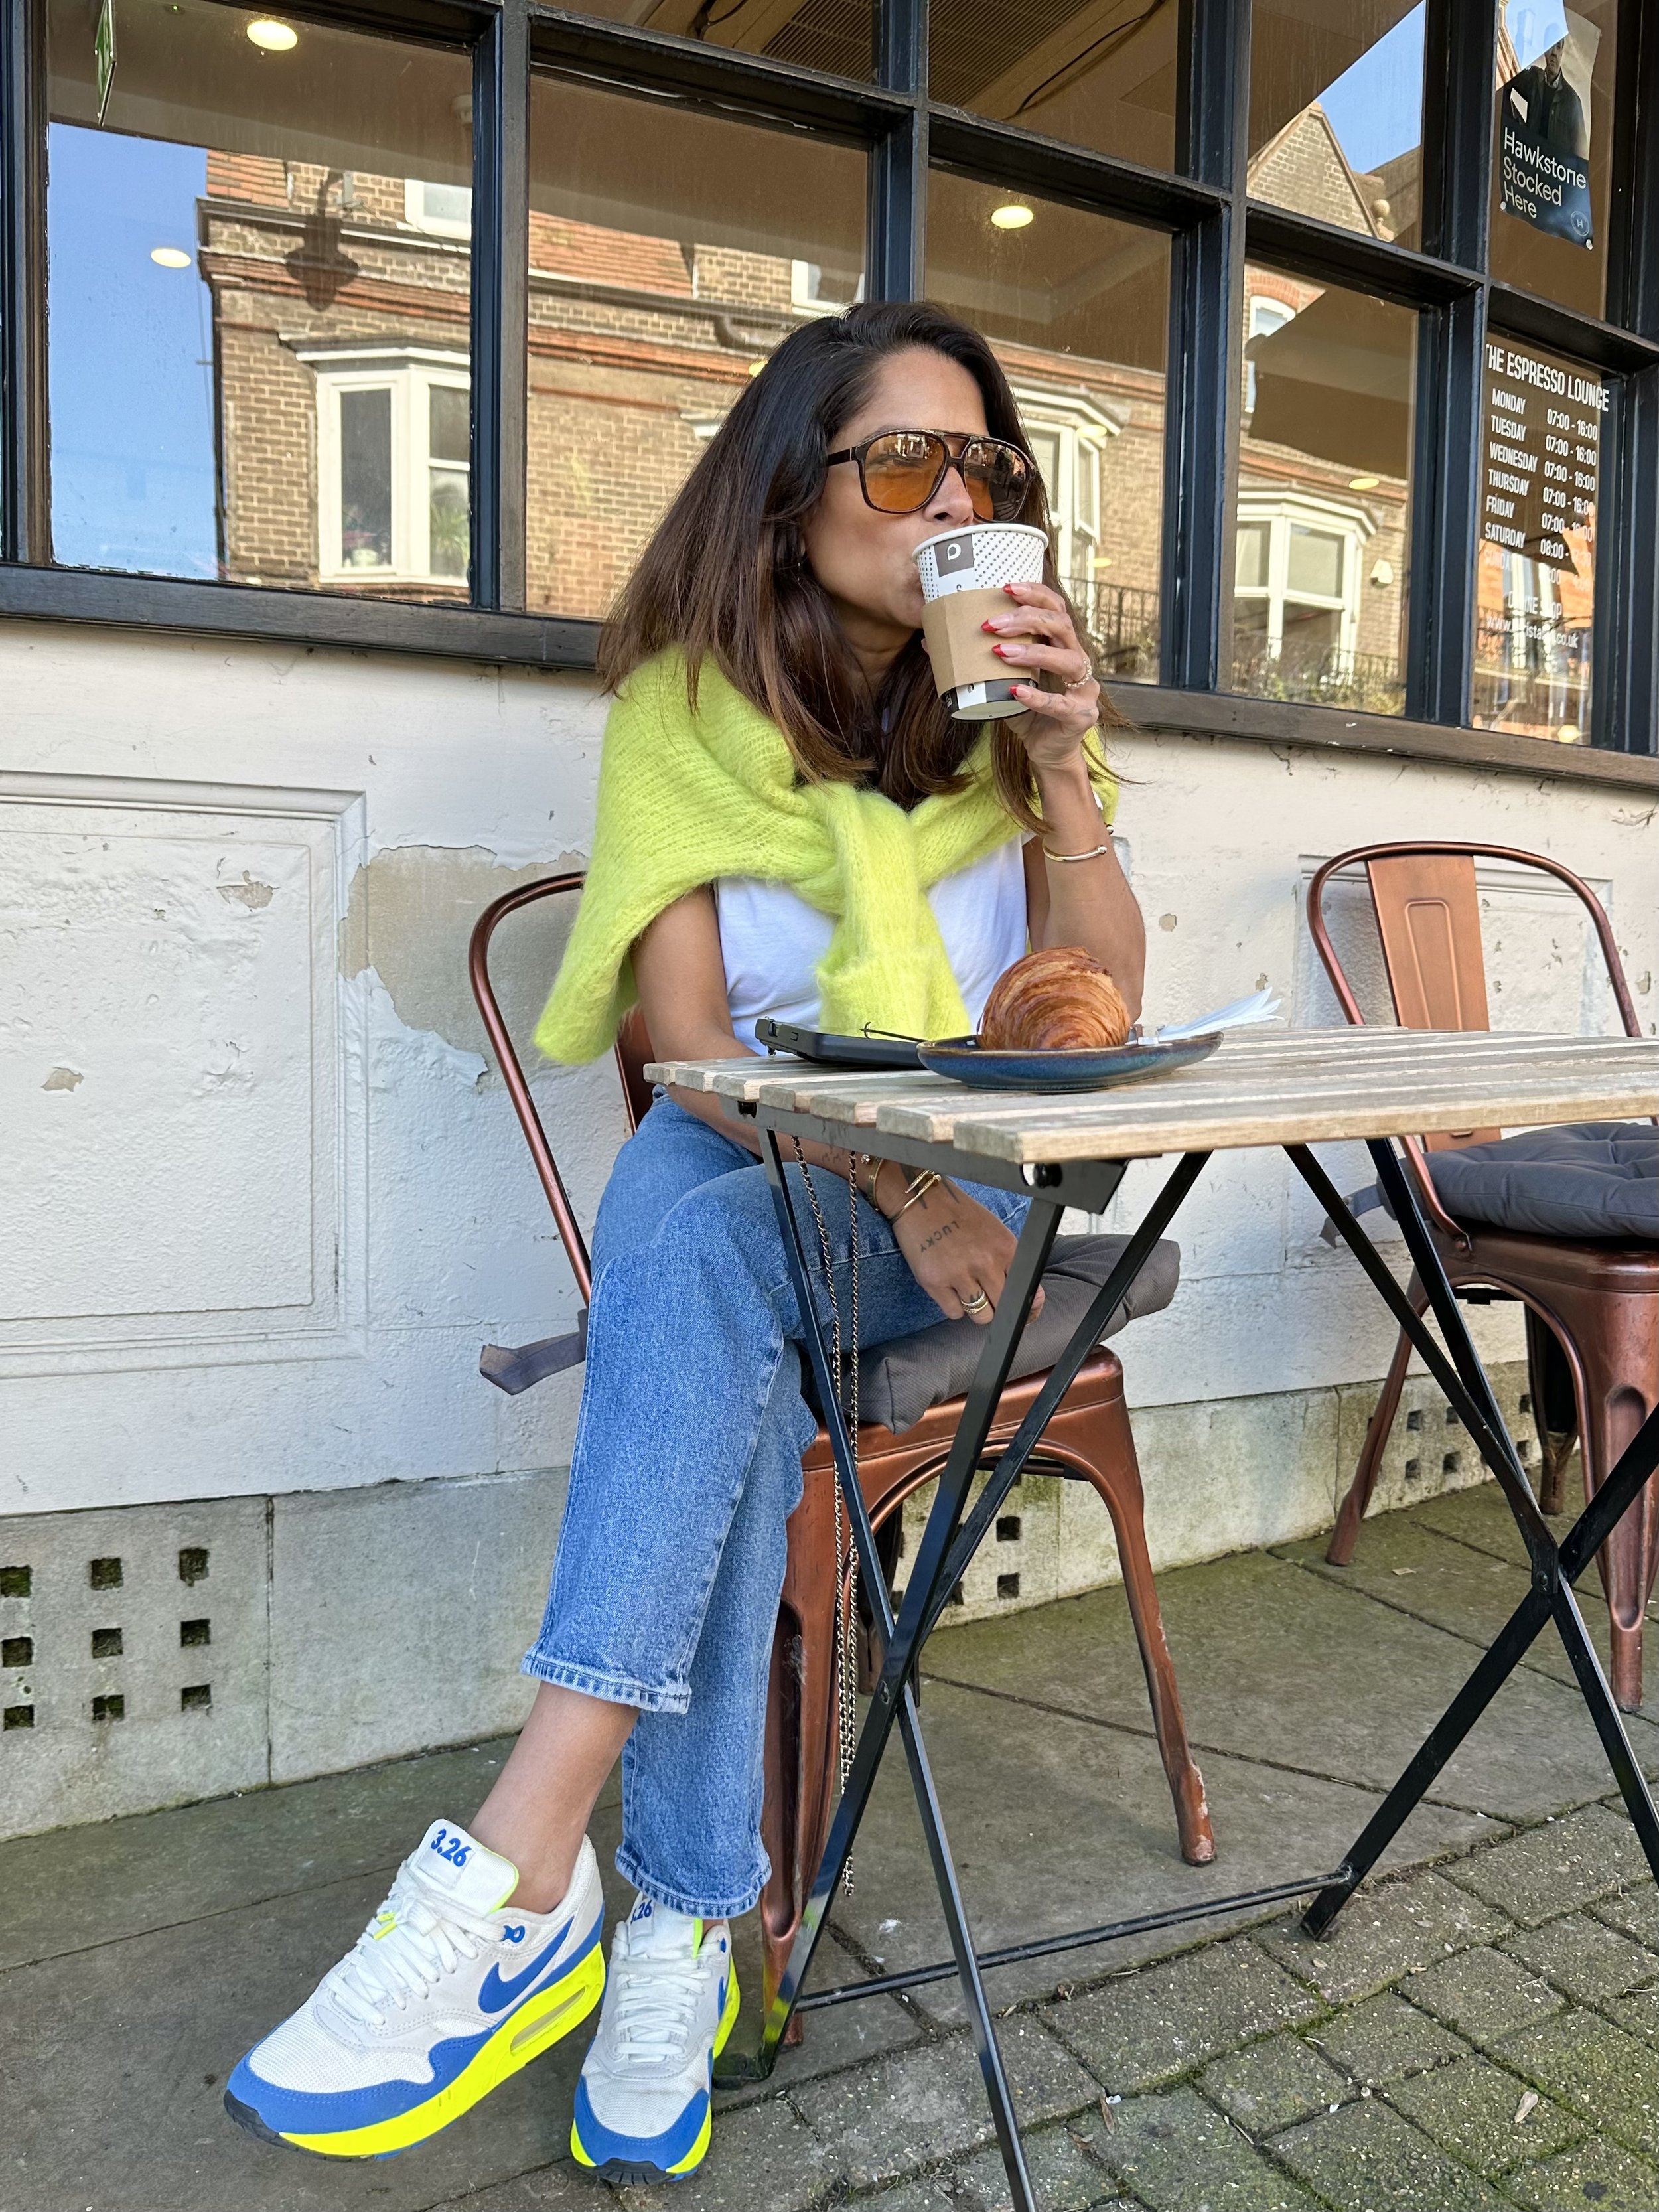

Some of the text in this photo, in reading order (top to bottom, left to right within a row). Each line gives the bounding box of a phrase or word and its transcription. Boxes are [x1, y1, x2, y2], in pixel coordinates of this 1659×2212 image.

[1504, 127, 1587, 190] Hawkstone
[1504, 156, 1562, 206] Stocked
[1504, 181, 1537, 219] Here
[1506, 352, 1565, 396] ESPRESSO
[1567, 375, 1610, 412] LOUNGE
[1492, 388, 1526, 415] MONDAY
[1547, 408, 1570, 431] 07:00
[1577, 419, 1598, 441] 16:00
[1491, 415, 1526, 441] TUESDAY
[1546, 435, 1569, 457] 07:00
[1575, 445, 1597, 467] 16:00
[1490, 441, 1538, 473] WEDNESDAY
[1544, 461, 1567, 482] 07:00
[1574, 471, 1595, 492] 16:00
[1486, 495, 1515, 519] FRIDAY
[1542, 512, 1565, 534] 07:00
[1488, 469, 1530, 496] THURSDAY
[1543, 486, 1566, 508] 07:00
[1573, 496, 1594, 517] 16:00
[1485, 522, 1526, 549] SATURDAY
[1540, 538, 1564, 559] 08:00
[920, 1220, 960, 1253] LUCKY
[431, 1828, 472, 1867] 3.26
